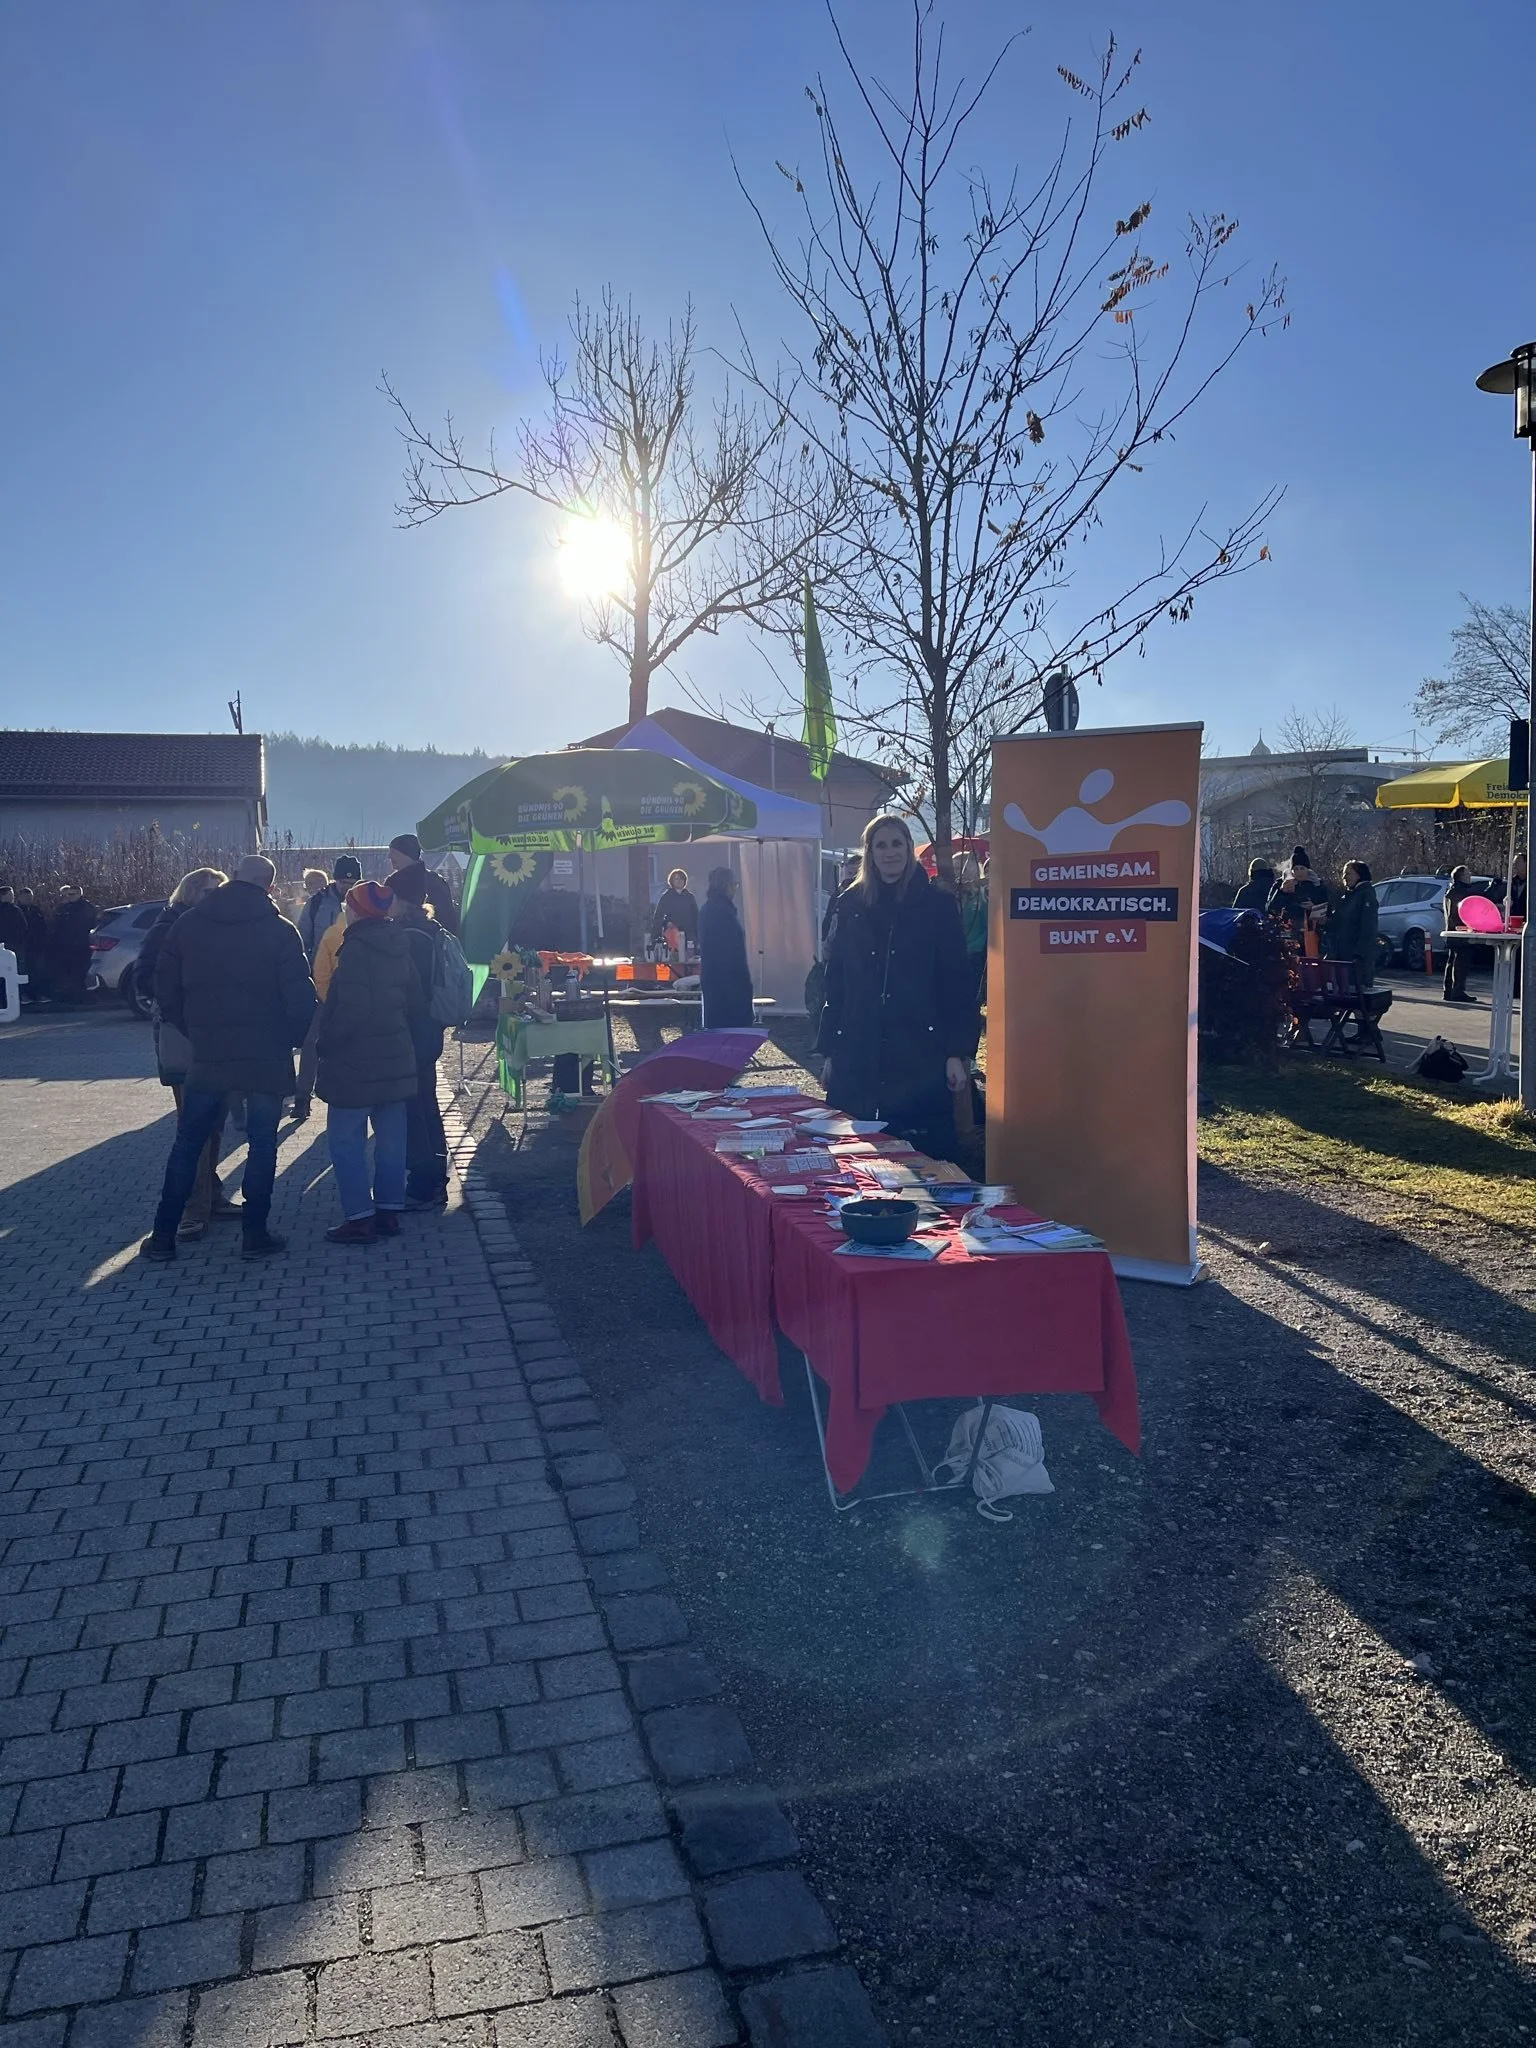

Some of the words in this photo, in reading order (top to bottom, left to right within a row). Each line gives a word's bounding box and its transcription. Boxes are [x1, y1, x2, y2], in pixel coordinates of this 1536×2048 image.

[640, 806, 652, 814] DIE
[518, 814, 531, 823] DIE
[1035, 861, 1156, 882] GEMEINSAM.
[1017, 896, 1172, 912] DEMOKRATISCH.
[1049, 929, 1100, 945] BUNT
[1105, 928, 1138, 944] e.V.
